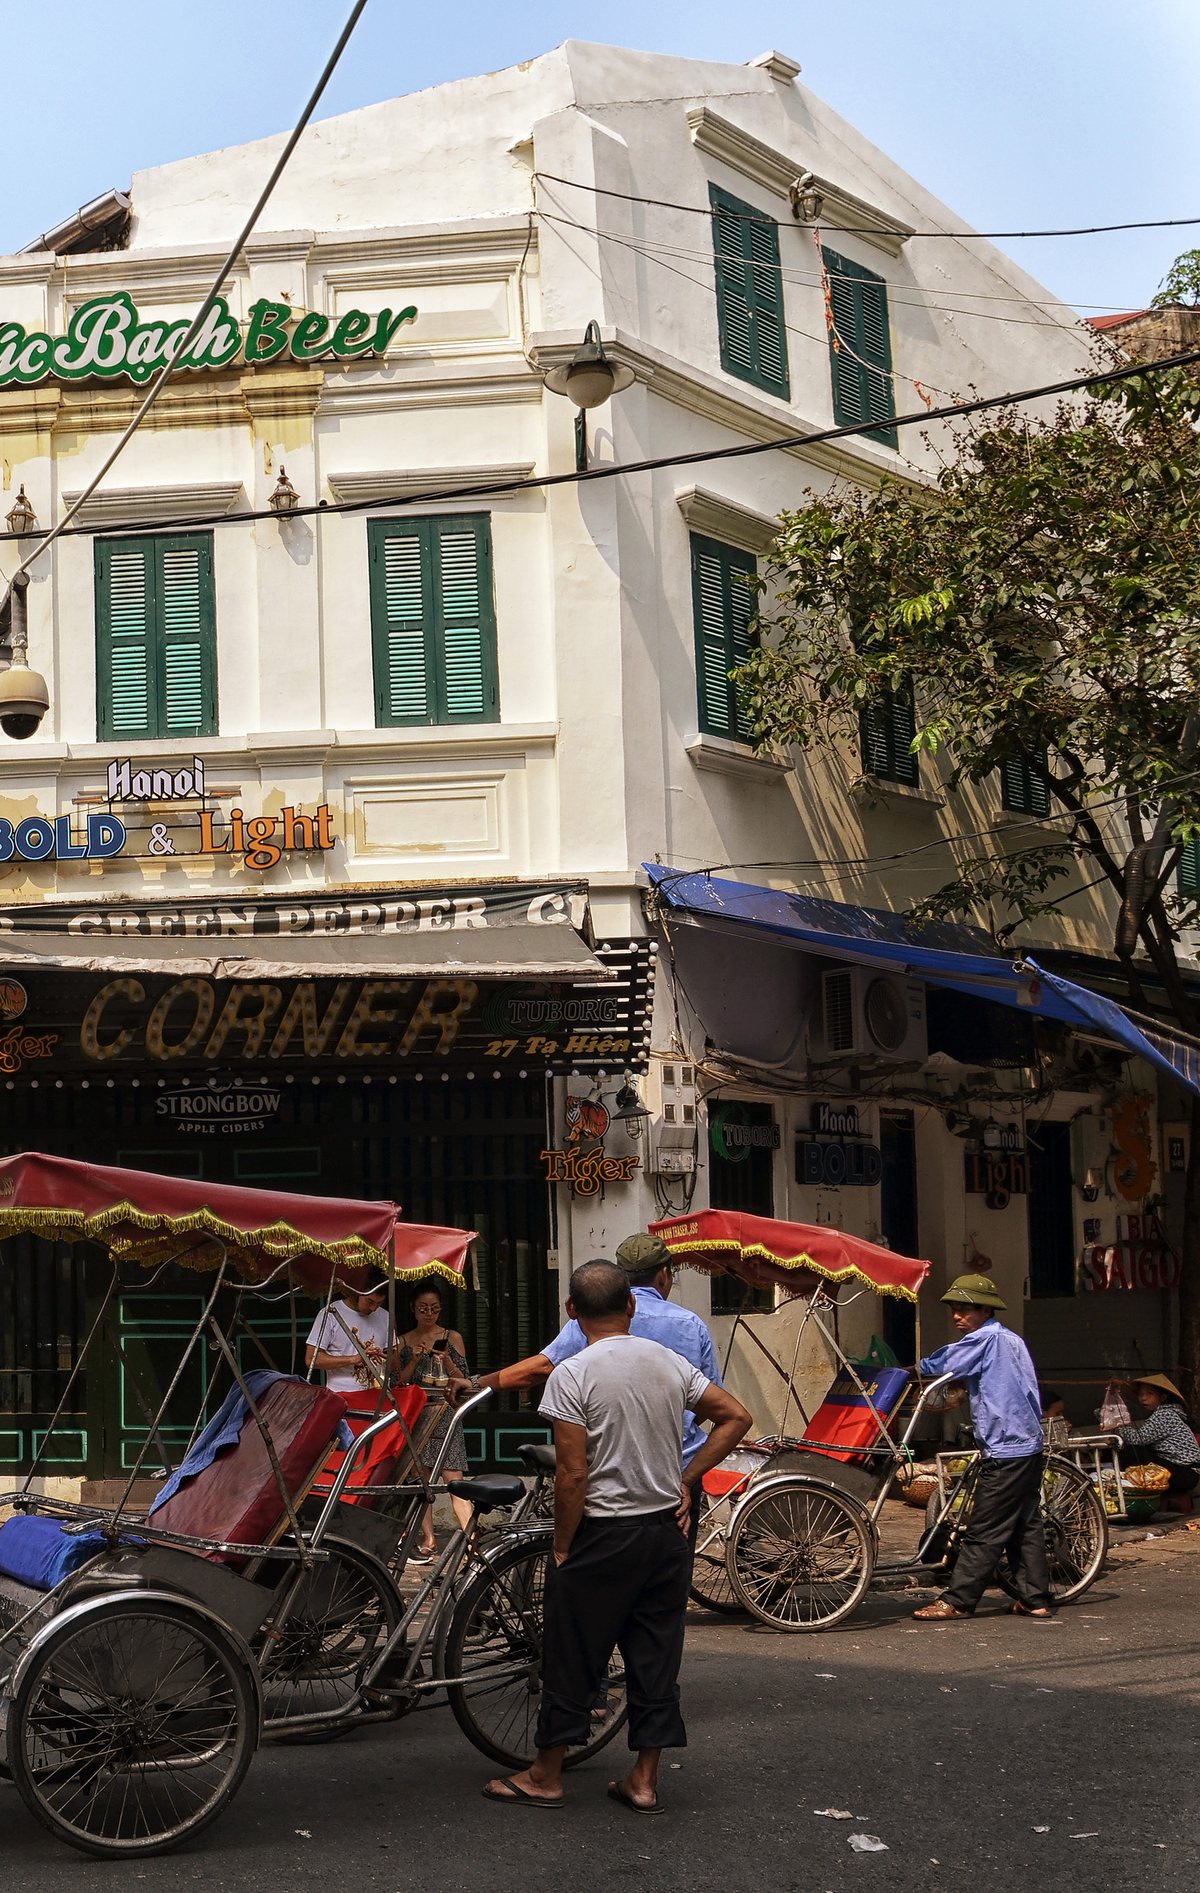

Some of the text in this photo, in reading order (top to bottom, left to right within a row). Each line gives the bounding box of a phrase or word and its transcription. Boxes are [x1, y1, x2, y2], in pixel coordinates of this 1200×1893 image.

[52, 292, 240, 384] Bạch
[245, 298, 419, 365] Beer
[106, 755, 205, 801] Hanoi
[148, 822, 175, 855] &
[199, 804, 335, 870] Light
[67, 906, 259, 937] GREEN
[275, 897, 492, 937] PEPPER
[79, 978, 479, 1061] CORNER
[508, 998, 618, 1024] TUBORG
[484, 1034, 631, 1058] 27 Tạ Hiện
[156, 1094, 280, 1114] STRONGBOW
[818, 1103, 859, 1136] Hanoi
[178, 1120, 265, 1133] APPLE CIDERS
[724, 1123, 780, 1148] TUBORG
[540, 1146, 641, 1196] Tiger
[803, 1142, 883, 1186] BOLD
[972, 1153, 1033, 1209] Light
[1126, 1215, 1165, 1242] BIA
[1088, 1246, 1182, 1291] SAIGO
